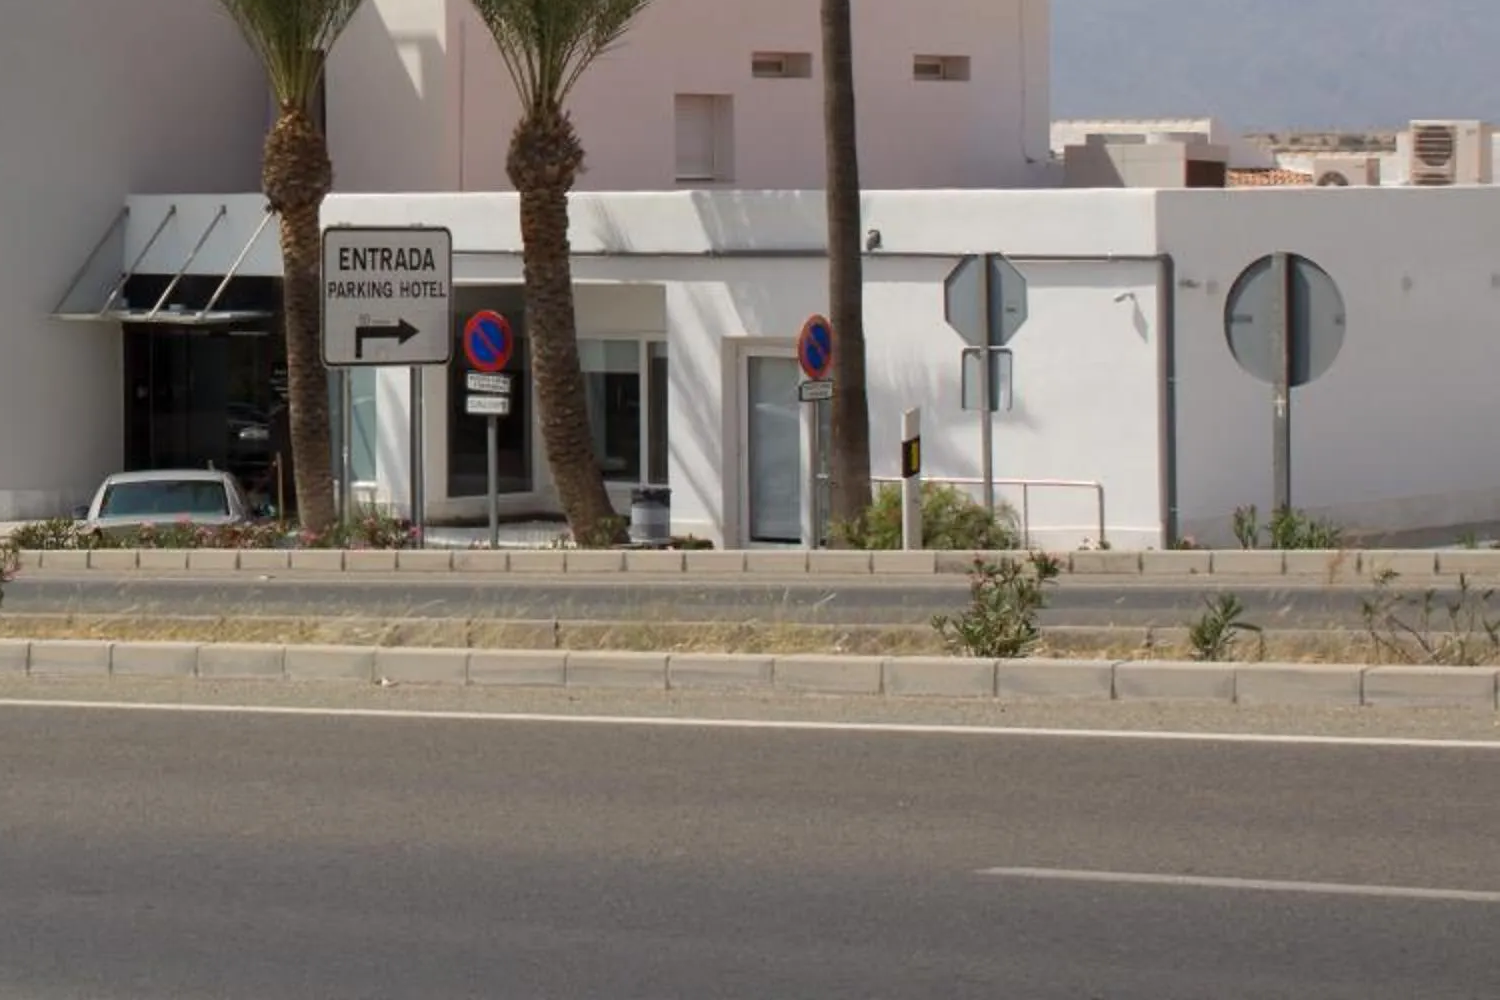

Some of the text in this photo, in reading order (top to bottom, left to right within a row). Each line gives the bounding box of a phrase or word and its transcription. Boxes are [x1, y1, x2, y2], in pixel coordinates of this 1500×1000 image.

[339, 247, 436, 271] ENTRADA
[327, 281, 447, 298] PARKING HOTEL
